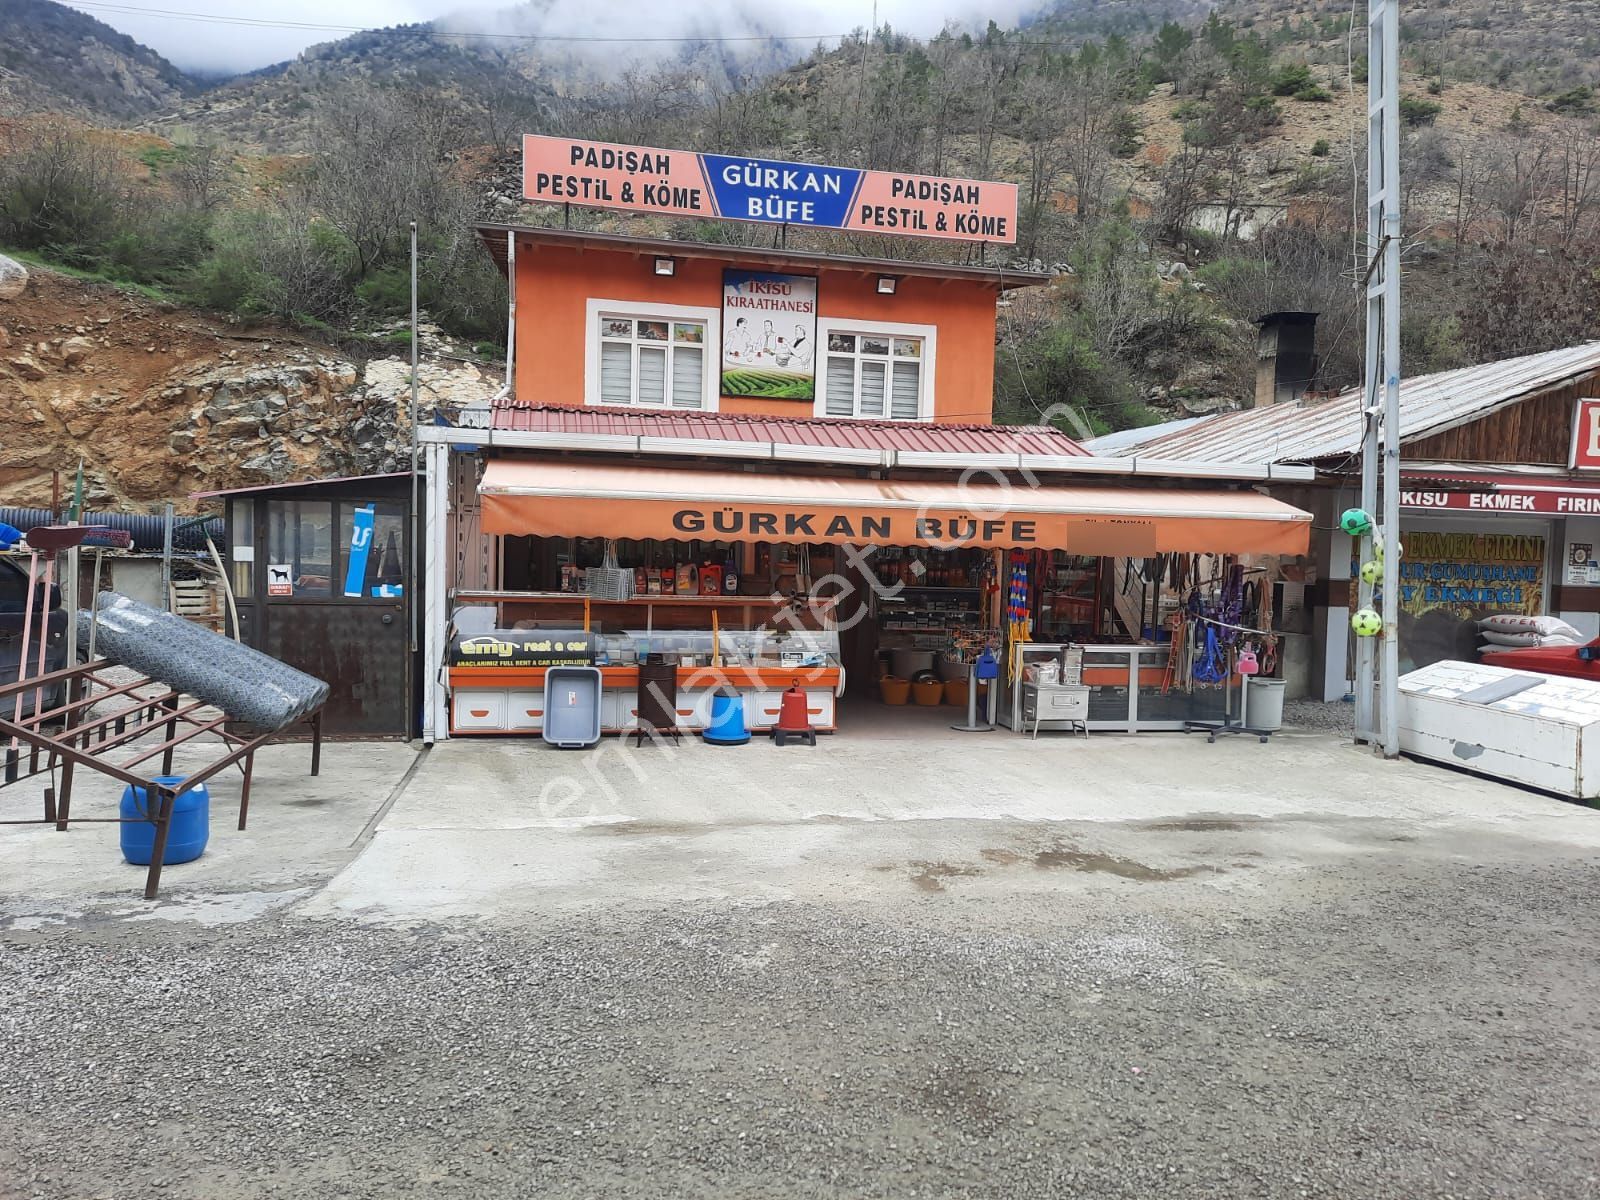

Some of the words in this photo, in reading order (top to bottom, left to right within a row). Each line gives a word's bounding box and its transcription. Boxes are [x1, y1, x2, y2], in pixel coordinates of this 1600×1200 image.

[721, 162, 842, 195] GÜRKAN
[620, 181, 635, 204] &
[643, 180, 701, 210] KÖME
[747, 194, 815, 222] BÜFE
[935, 211, 948, 232] &
[954, 209, 1007, 237] KÖME
[726, 295, 814, 314] KIRAATHANESİ
[1469, 493, 1536, 510] EKMEK
[672, 507, 892, 538] GÜRKAN
[915, 515, 1037, 541] BÜFE
[1407, 531, 1479, 560] EKMEK
[1483, 533, 1545, 562] FIRINI
